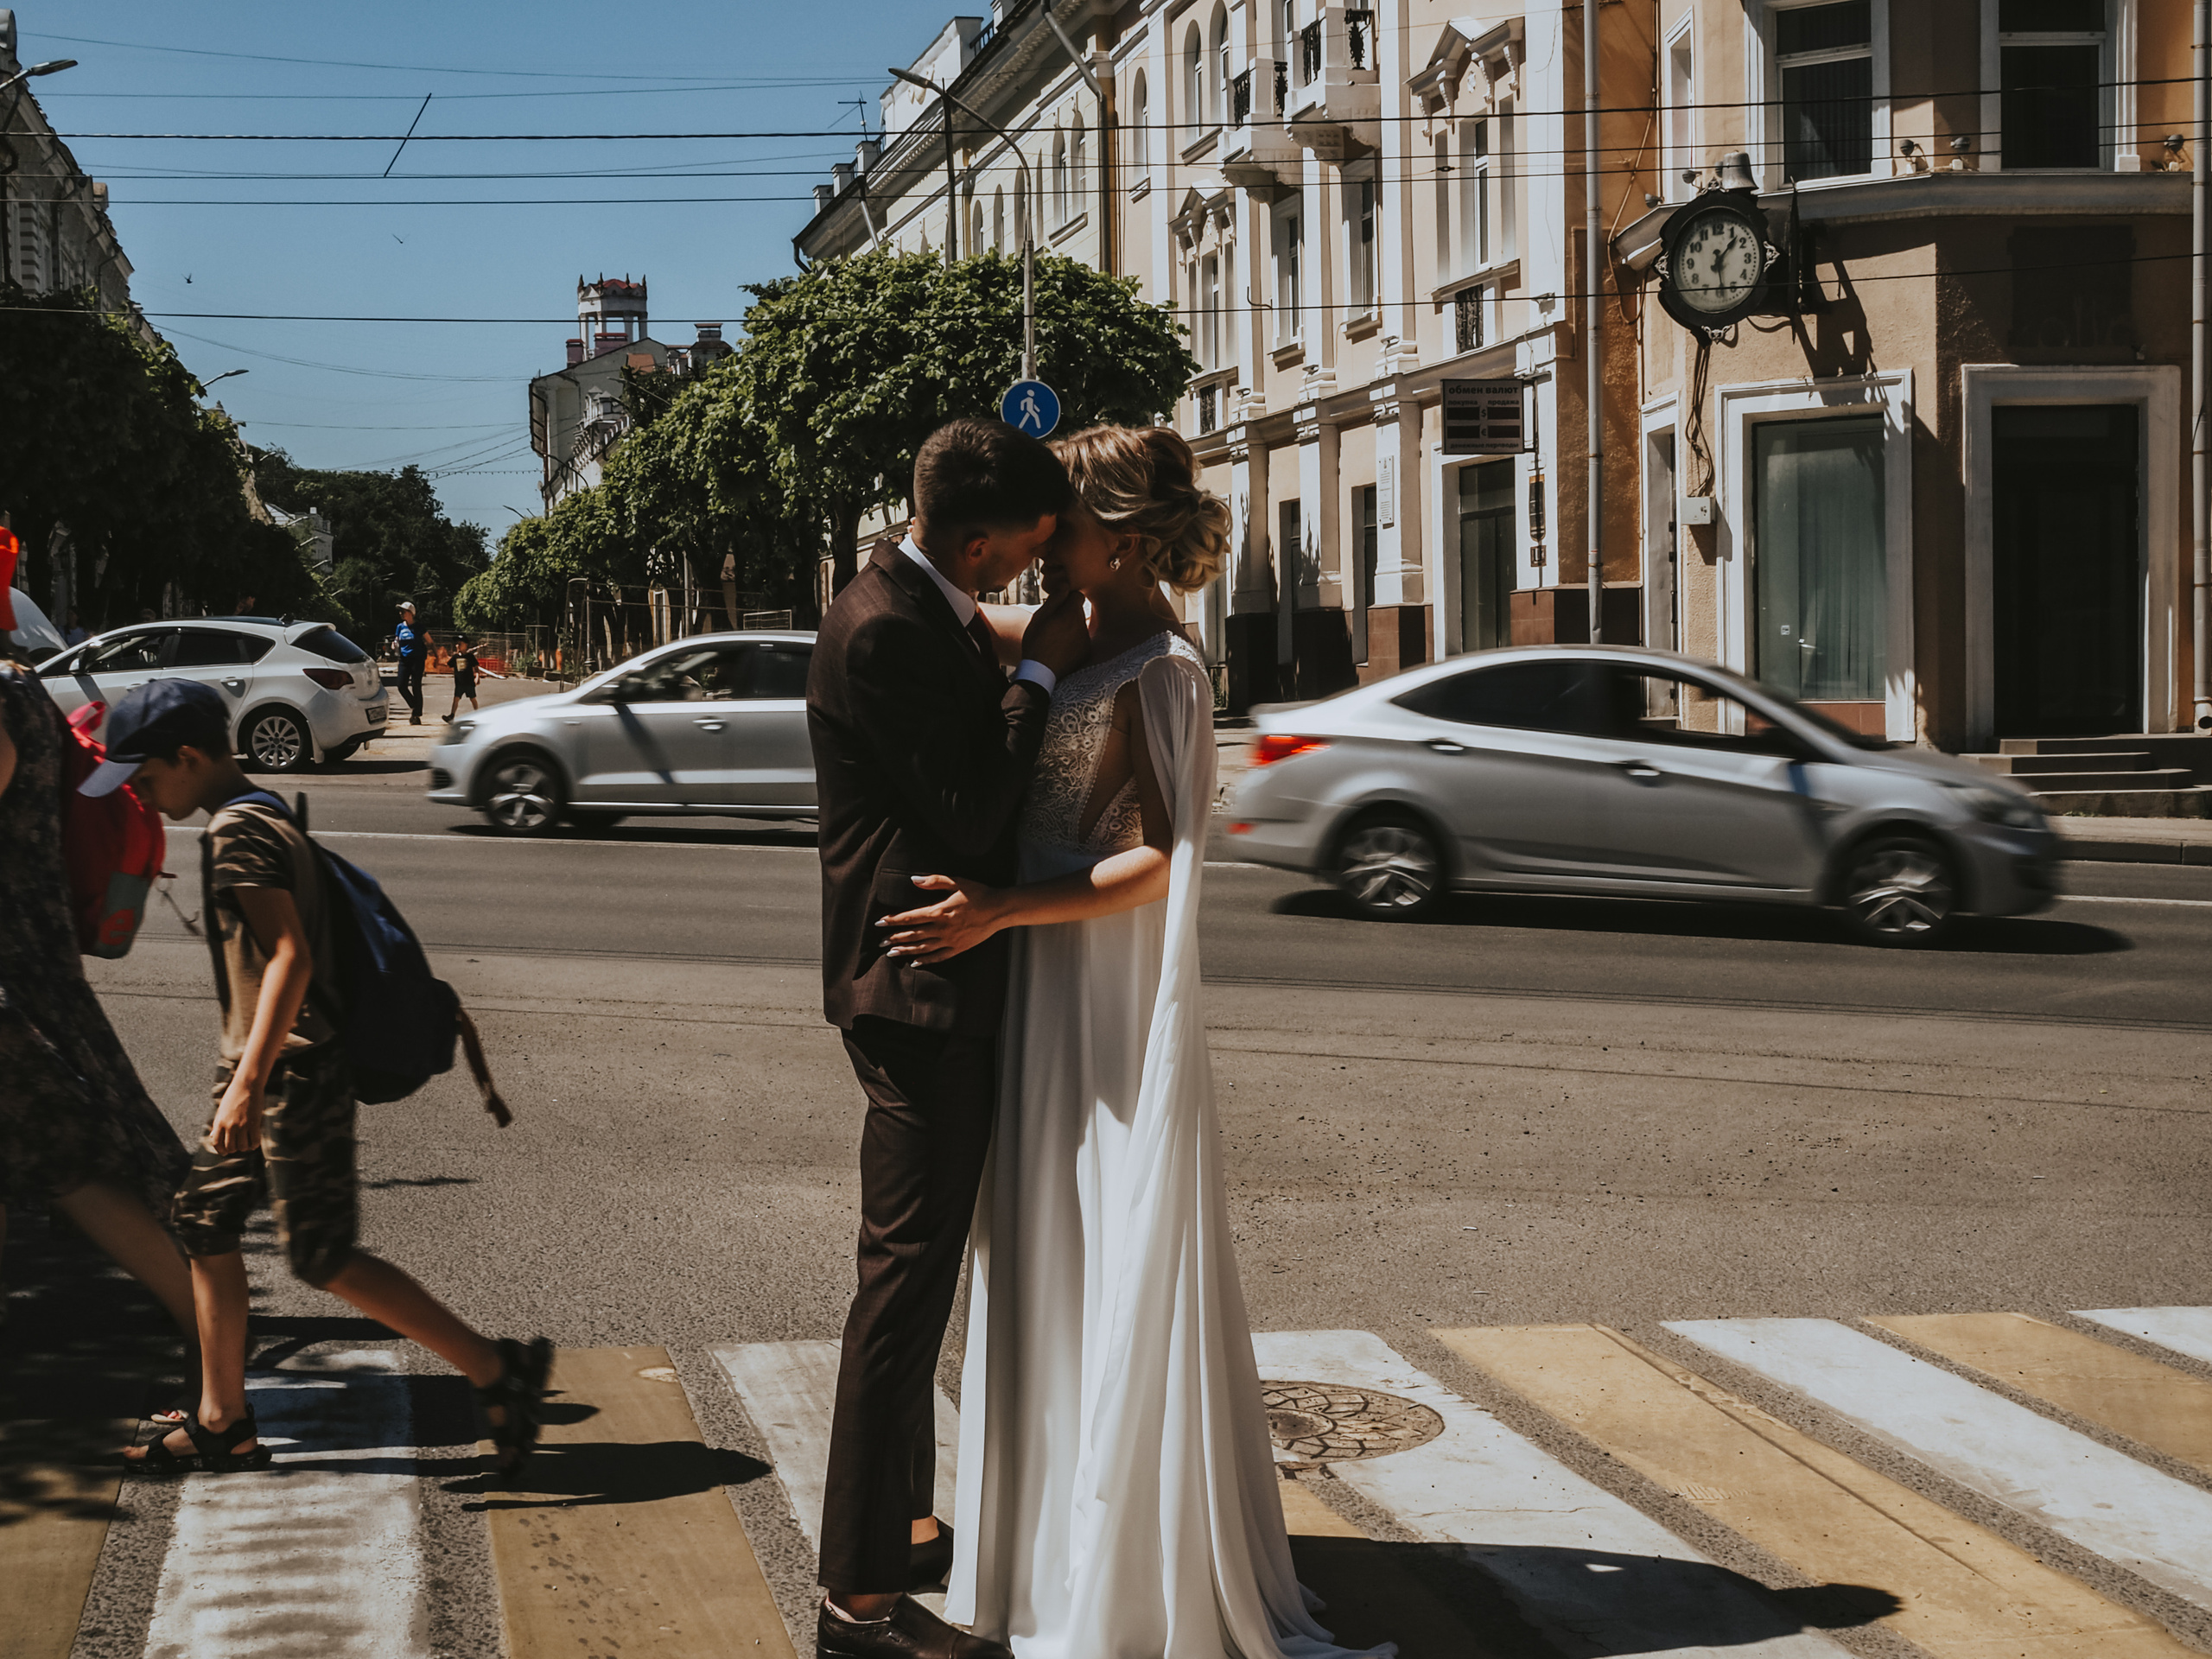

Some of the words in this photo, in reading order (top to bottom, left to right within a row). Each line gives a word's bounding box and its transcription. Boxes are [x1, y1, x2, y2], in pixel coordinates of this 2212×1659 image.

[1700, 229, 1708, 241] 11
[1712, 223, 1725, 236] 12
[1728, 226, 1735, 238] 1
[1689, 242, 1702, 253] 10
[1739, 237, 1747, 249] 2
[1686, 258, 1694, 270] 9
[1744, 252, 1751, 264] 3
[1691, 273, 1700, 284] 8
[1739, 269, 1747, 281] 4
[1449, 385, 1484, 394] обмен
[1481, 409, 1486, 417] $
